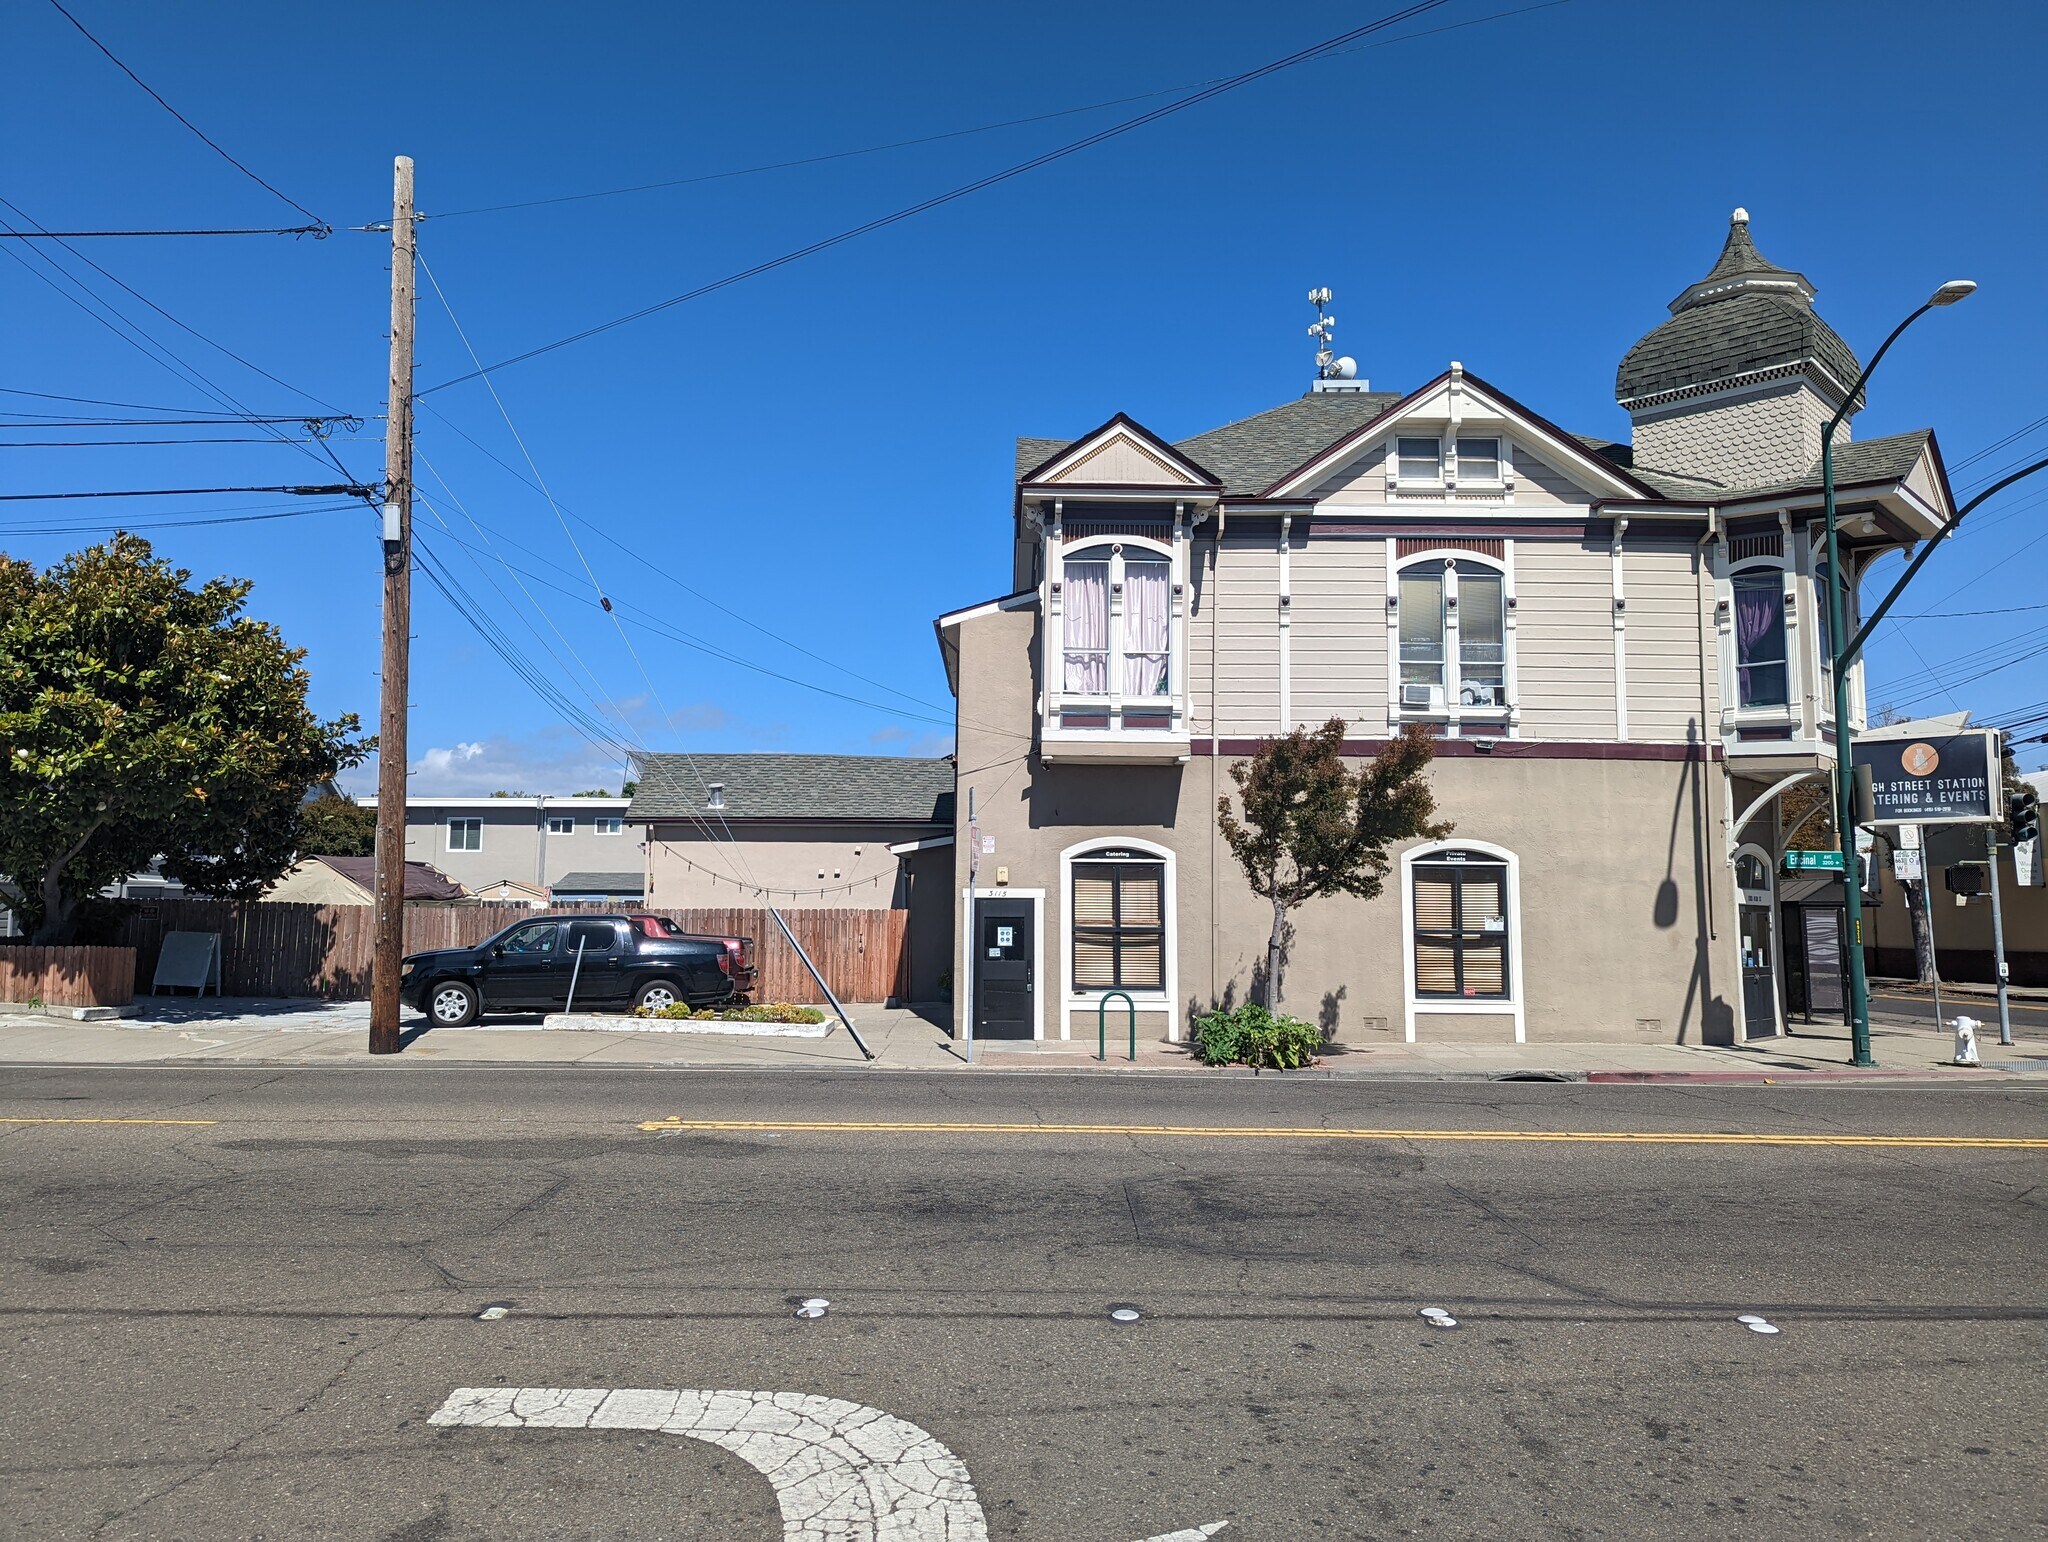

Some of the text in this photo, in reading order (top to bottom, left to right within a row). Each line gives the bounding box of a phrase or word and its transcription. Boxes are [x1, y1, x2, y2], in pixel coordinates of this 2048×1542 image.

[1872, 778, 1986, 792] GH STREET STATION
[1872, 790, 1987, 805] TERING & EVENTS
[988, 890, 1007, 898] 3115
